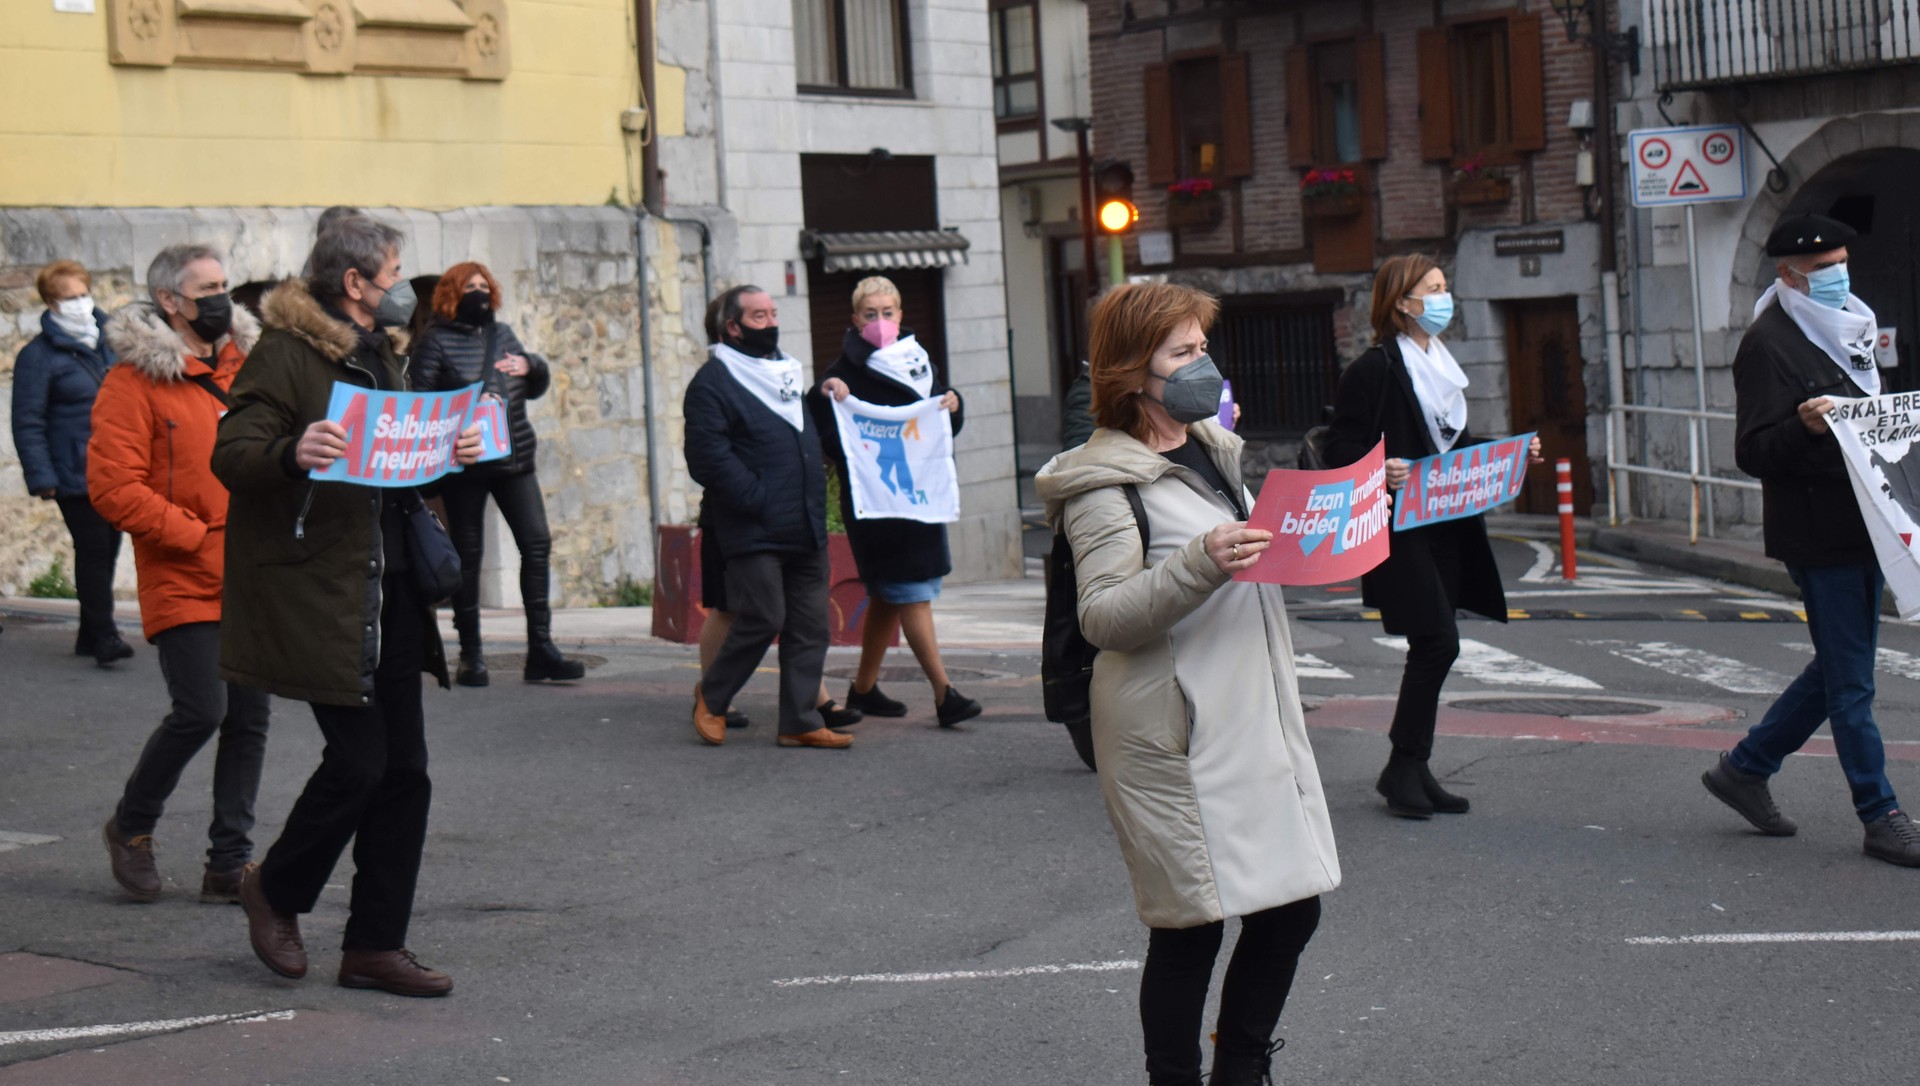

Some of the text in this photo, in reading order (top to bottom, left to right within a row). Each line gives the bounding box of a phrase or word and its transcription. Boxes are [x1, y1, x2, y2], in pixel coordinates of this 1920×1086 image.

[1709, 143, 1728, 155] 30
[1876, 412, 1911, 428] ETA
[1426, 457, 1511, 489] Salbuespen
[1305, 489, 1345, 512] izan
[1427, 480, 1504, 512] neurriekin
[1279, 511, 1340, 536] bidea
